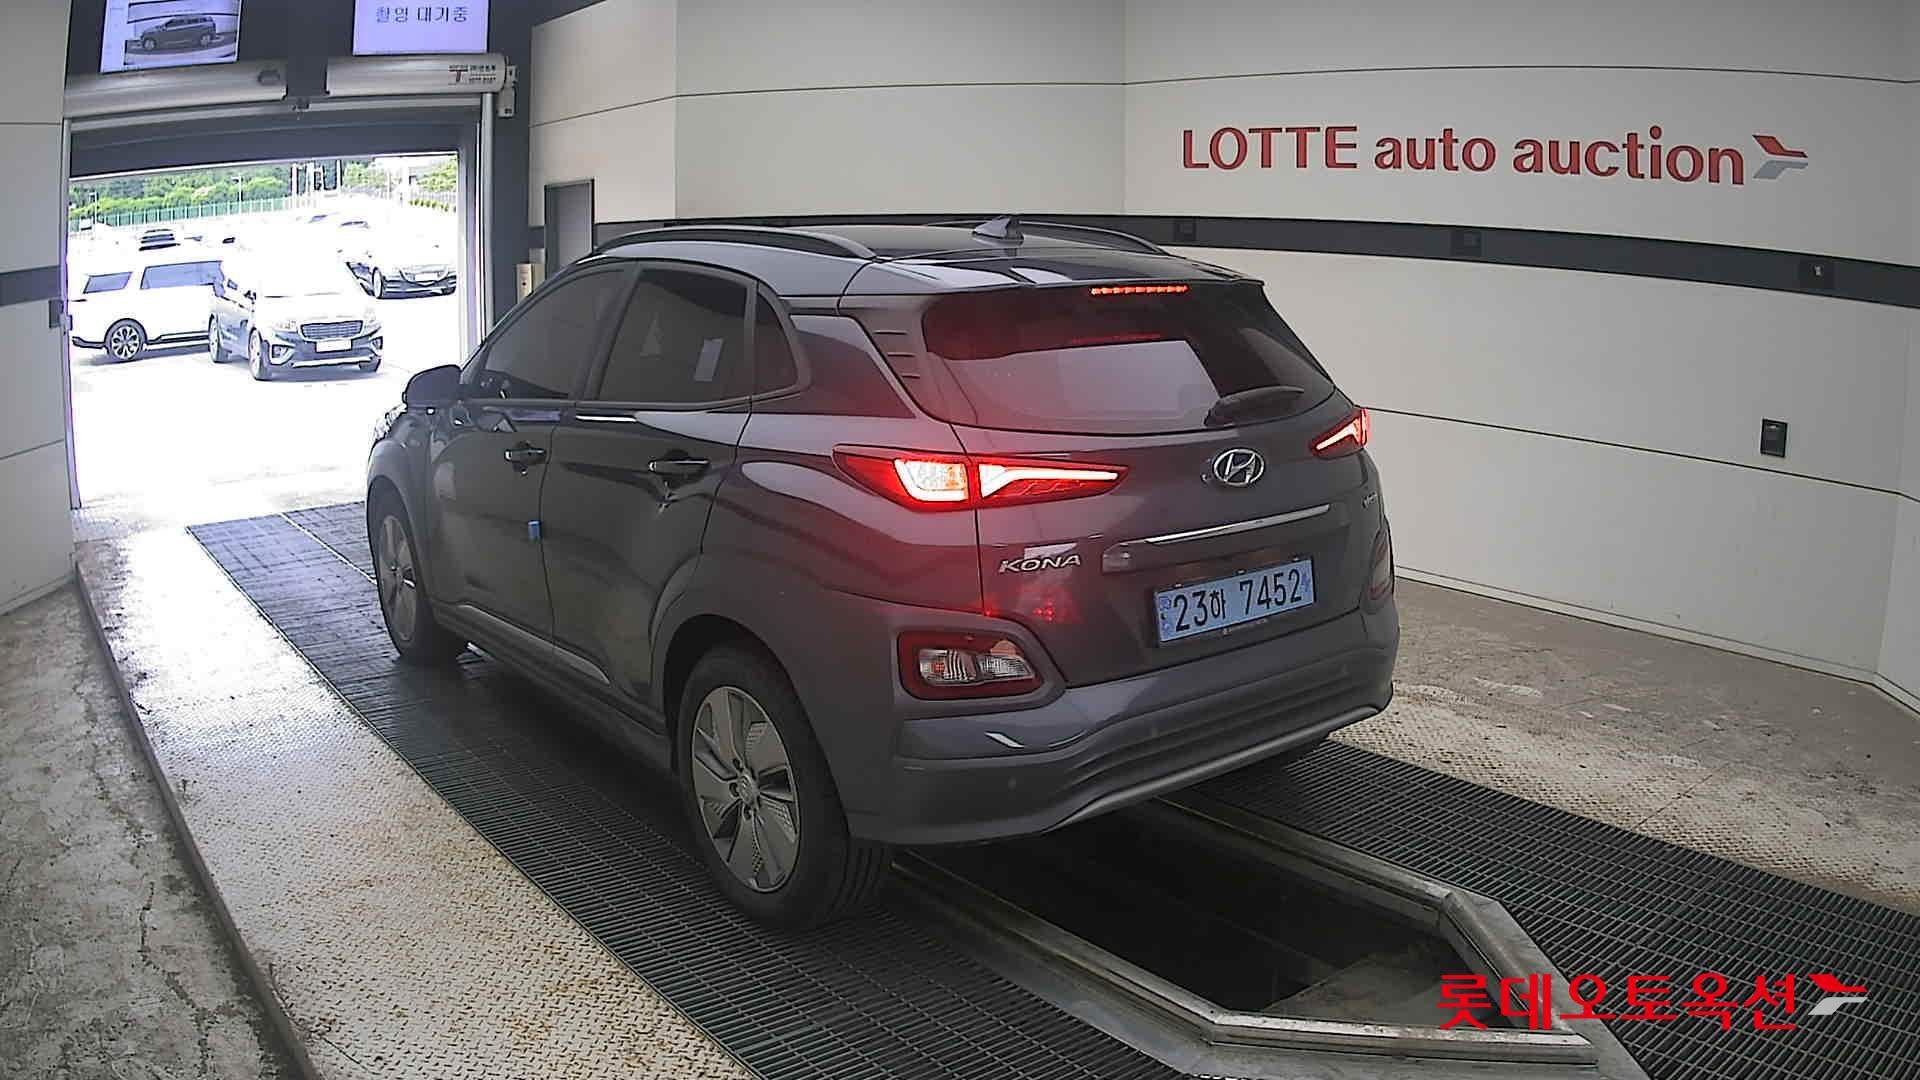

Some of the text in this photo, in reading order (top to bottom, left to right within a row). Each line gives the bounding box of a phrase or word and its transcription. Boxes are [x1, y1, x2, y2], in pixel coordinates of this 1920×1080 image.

[417, 6, 468, 23] 대기중
[1182, 125, 1745, 186] LOTTE auto auction
[999, 554, 1081, 573] KONA
[1173, 568, 1302, 632] 23하 7452
